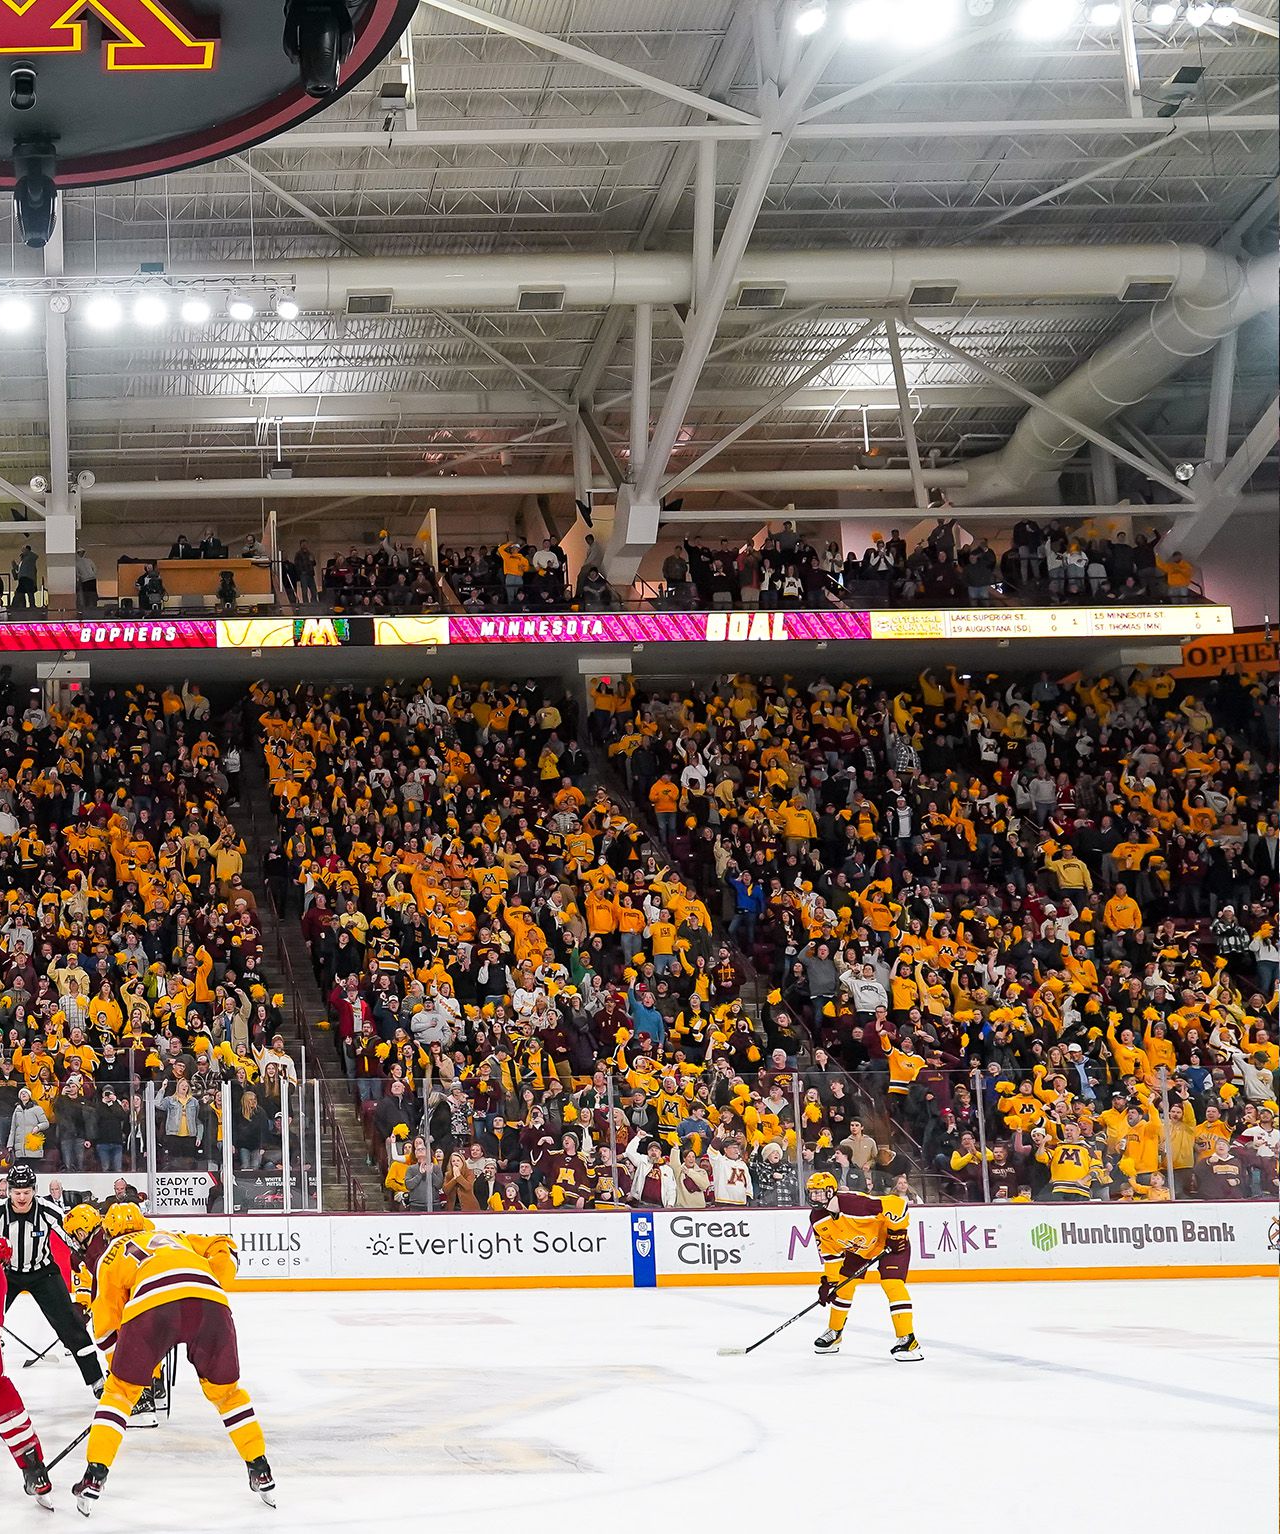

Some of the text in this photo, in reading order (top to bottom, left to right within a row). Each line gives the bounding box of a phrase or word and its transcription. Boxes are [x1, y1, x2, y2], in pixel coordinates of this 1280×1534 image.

[80, 626, 177, 643] GOPHERS
[480, 620, 604, 637] MINNESOTA
[1058, 1147, 1082, 1166] M
[156, 1177, 207, 1186] READY TO
[727, 1167, 747, 1188] M
[174, 1187, 194, 1196] THE
[192, 1198, 208, 1206] MIL
[670, 1215, 749, 1238] Great
[1062, 1220, 1235, 1249] Huntington Bank
[240, 1232, 301, 1252] HILLS
[398, 1231, 607, 1259] Everlight Solar
[678, 1242, 742, 1270] Clips
